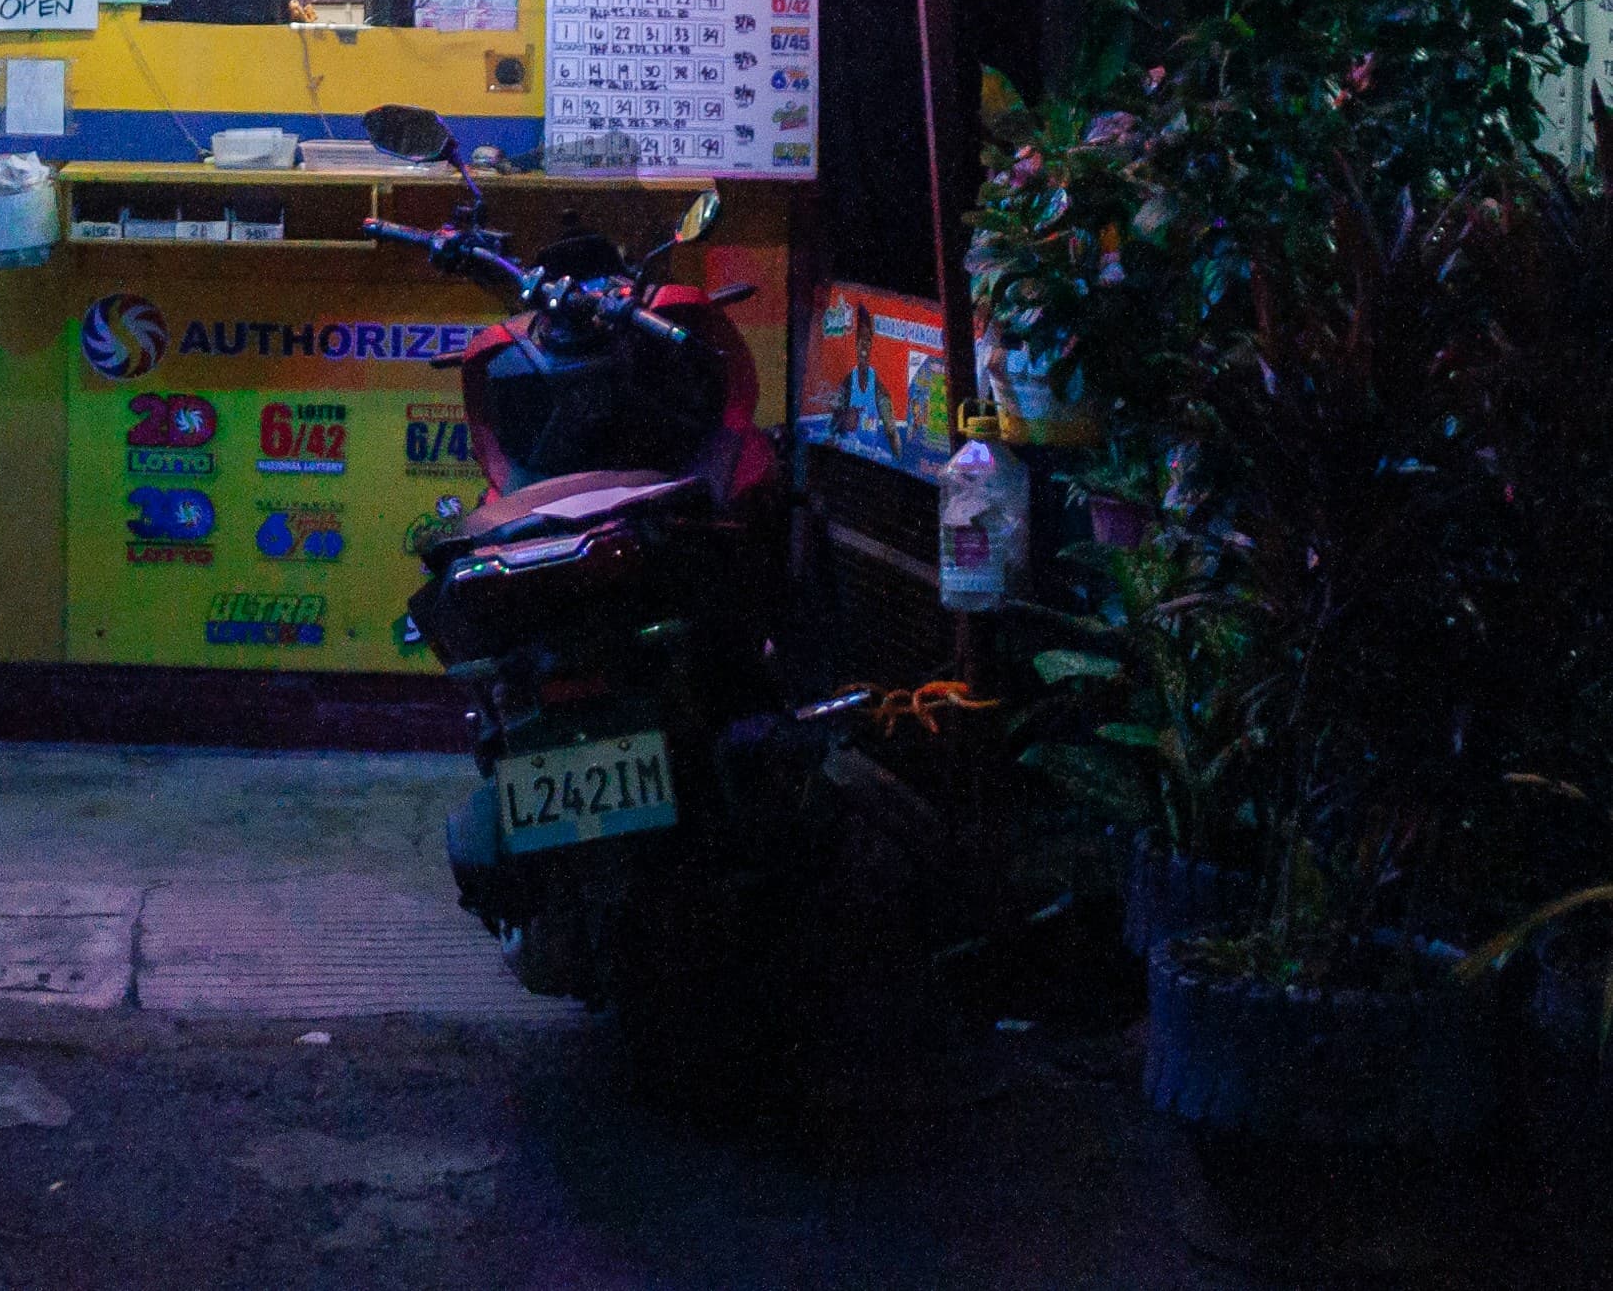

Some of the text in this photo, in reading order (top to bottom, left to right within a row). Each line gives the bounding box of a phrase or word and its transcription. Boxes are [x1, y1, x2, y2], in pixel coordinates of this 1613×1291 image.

[589, 25, 604, 40] 16
[615, 26, 630, 40] 22
[645, 26, 659, 41] 31
[674, 28, 689, 42] 33
[771, 34, 810, 51] 6/45
[583, 99, 600, 115] 32
[644, 100, 660, 115] 37
[298, 404, 346, 420] LOTTO
[259, 402, 346, 460] 6/42
[406, 421, 474, 463] 6/4
[131, 452, 212, 471] LOTTO
[127, 546, 214, 564] LOTTO
